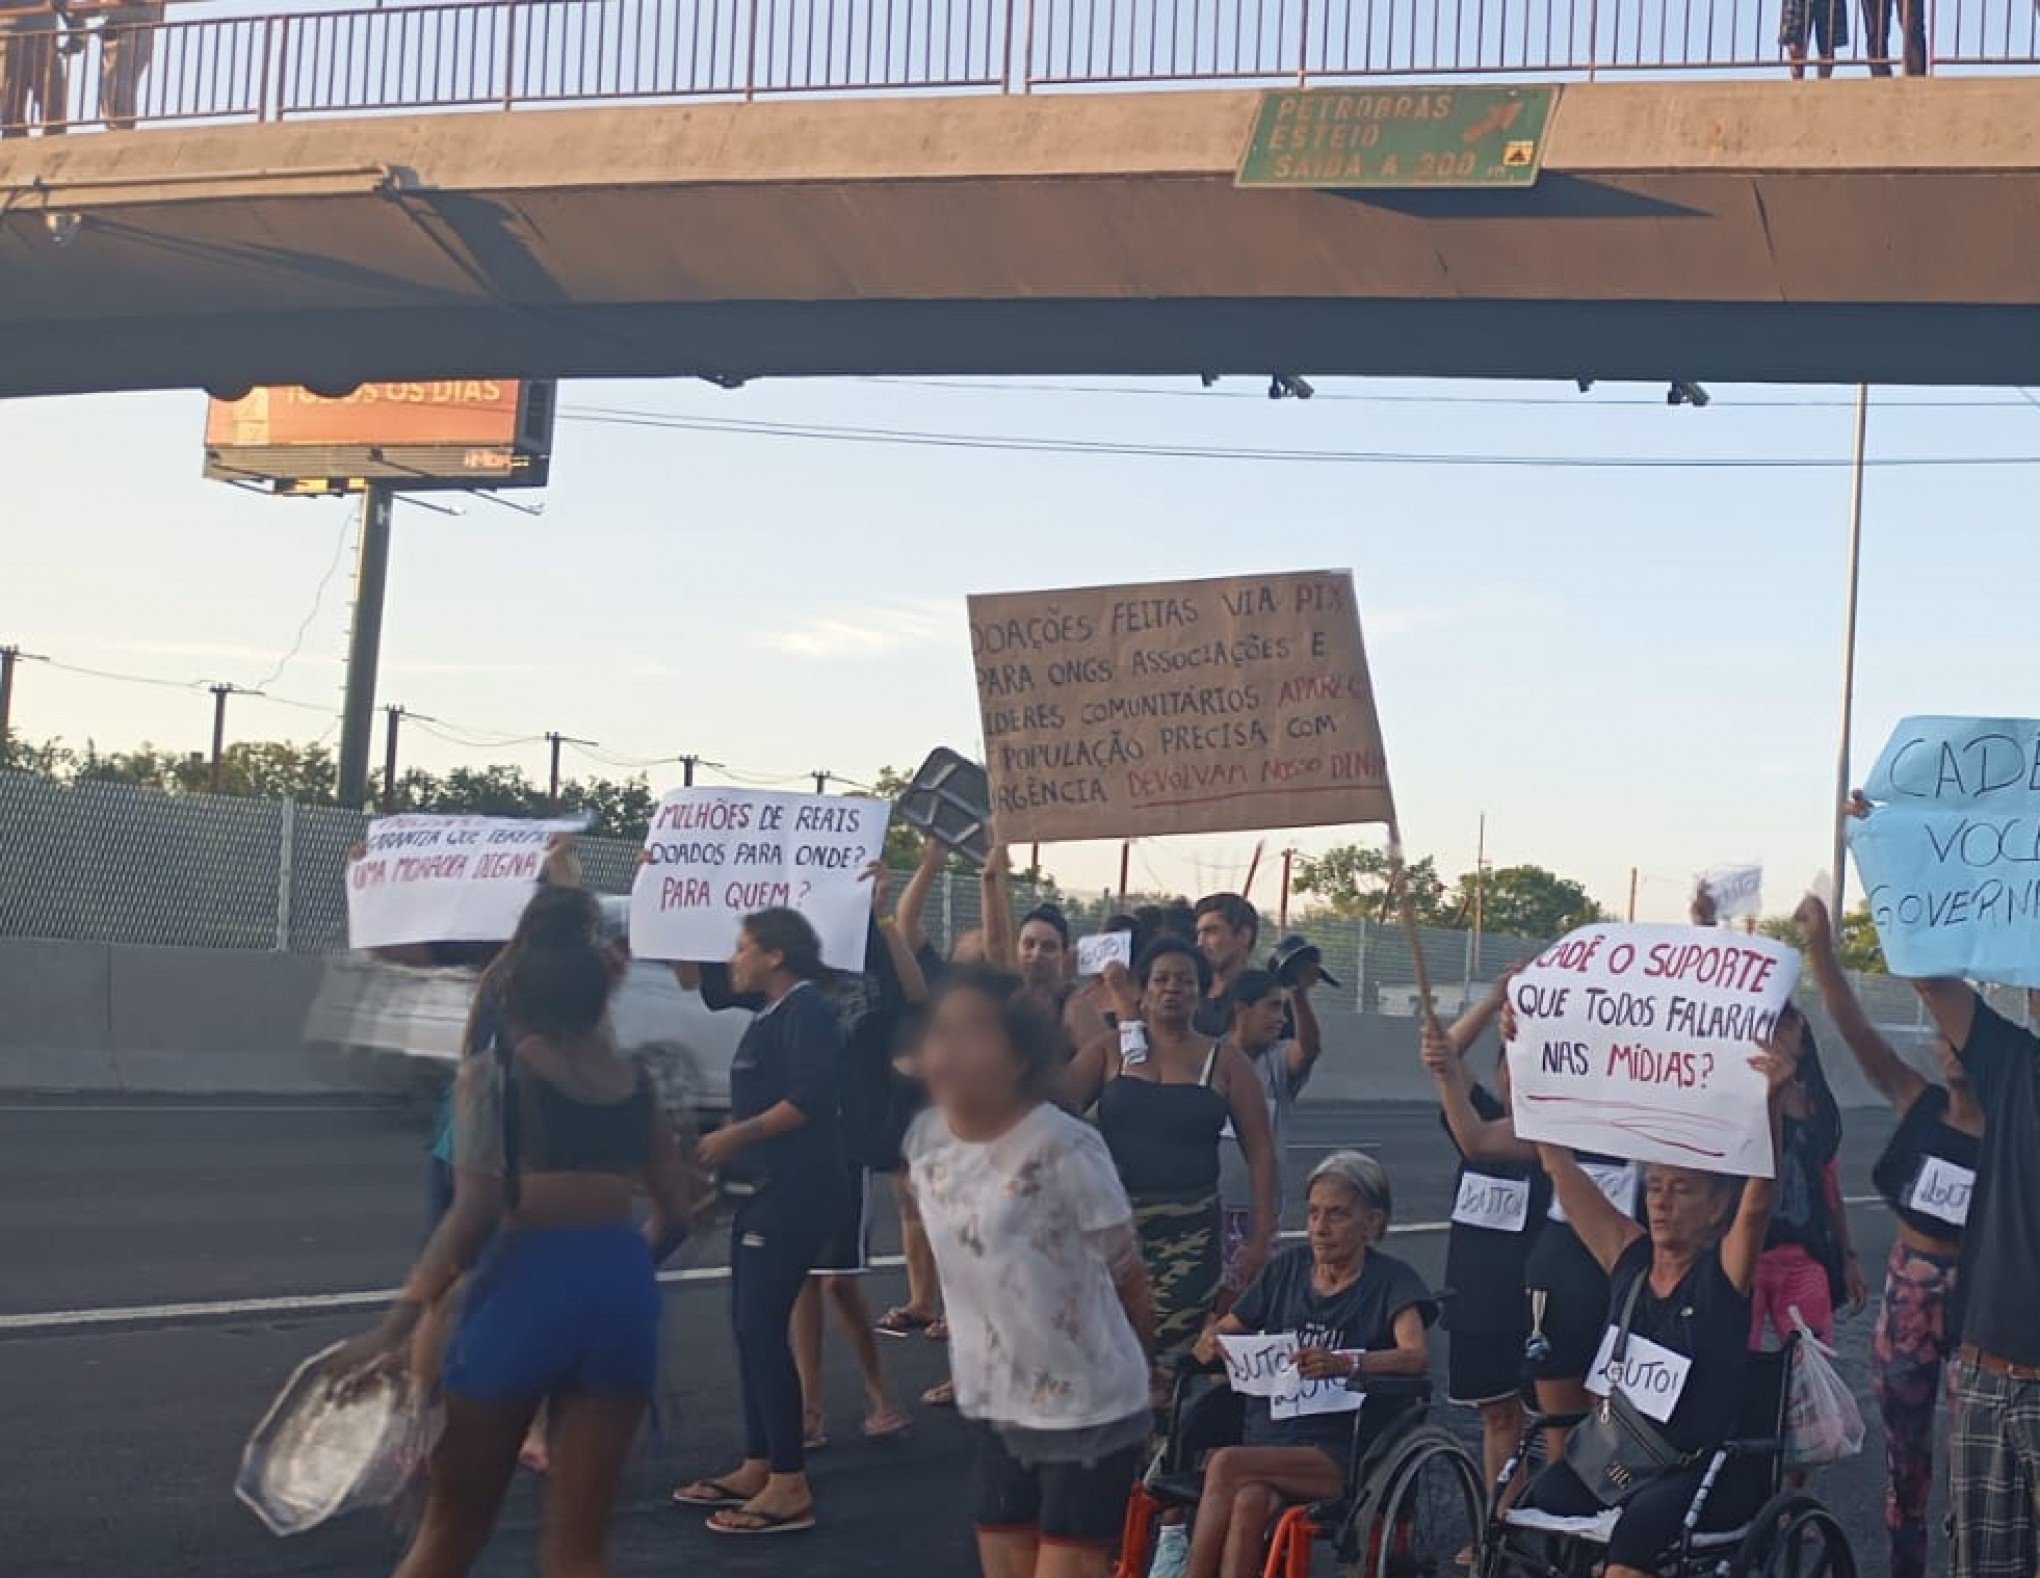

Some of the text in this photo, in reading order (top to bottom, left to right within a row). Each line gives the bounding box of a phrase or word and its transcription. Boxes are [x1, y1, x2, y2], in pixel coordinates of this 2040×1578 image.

[1279, 95, 1452, 121] PETROBRAS
[1269, 123, 1380, 149] ESTEIO
[1379, 154, 1397, 177] A
[1416, 151, 1477, 178] 200
[1111, 599, 1199, 636] FEITAS
[1224, 585, 1276, 617] VIA
[1047, 658, 1113, 687] ONGS
[1312, 630, 1326, 657] E
[1000, 713, 1337, 773] POPULAÇÃO PRECISA COM
[993, 774, 1110, 815] RGÊNCIA
[656, 799, 861, 833] MILHÕES DE REAIS
[733, 843, 783, 867] PARA
[795, 845, 866, 869] ONDE?
[1923, 817, 2040, 868] VOC
[660, 876, 711, 913] PARA
[1868, 878, 2040, 932] GOVERN
[1608, 943, 1636, 975] O
[1643, 942, 1778, 993] SUPORTE
[1516, 983, 1571, 1019] QUE
[1585, 986, 1656, 1028] TODOS
[1541, 1040, 1590, 1076] NAS
